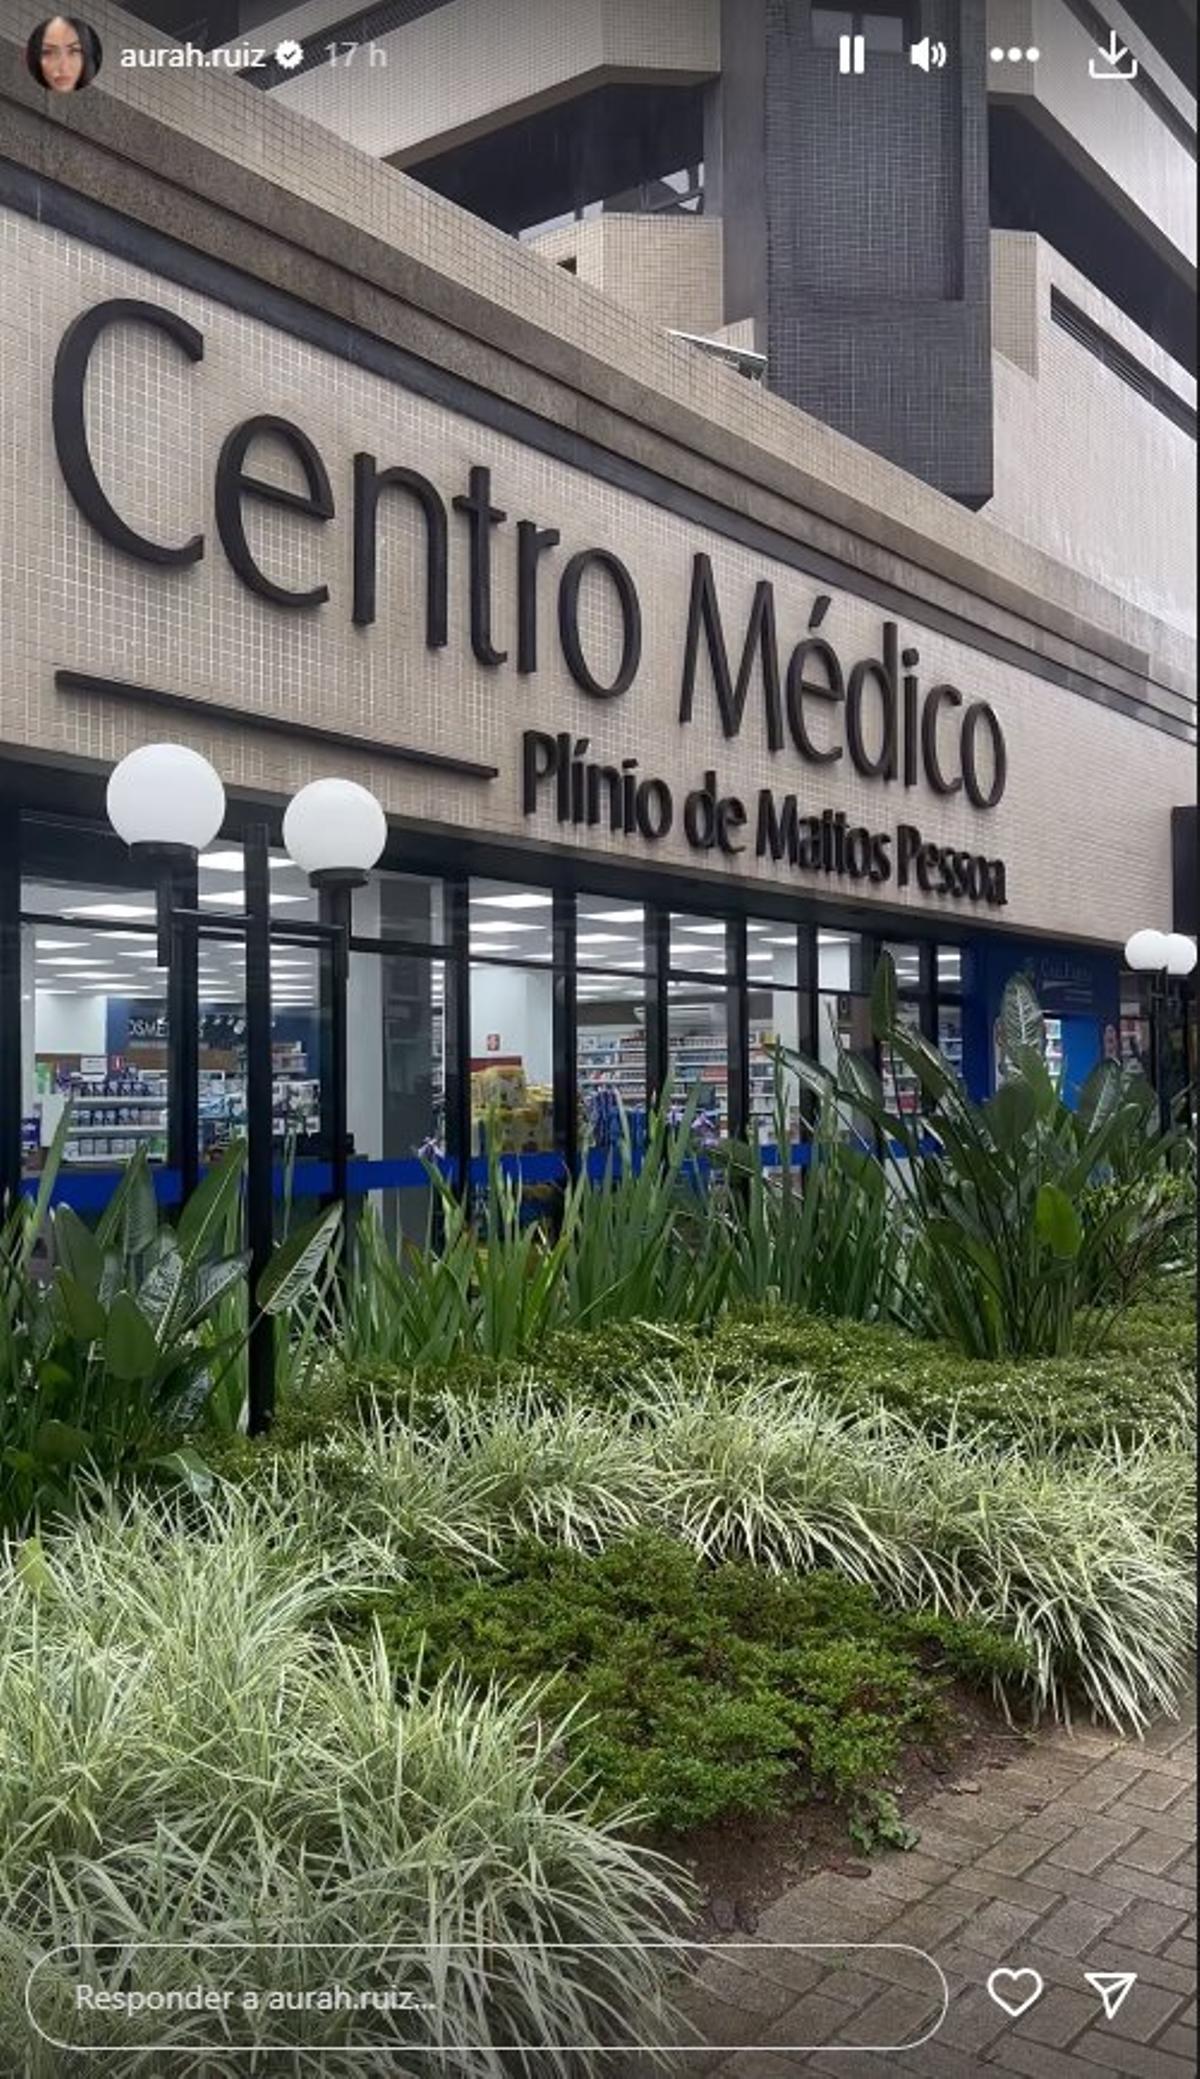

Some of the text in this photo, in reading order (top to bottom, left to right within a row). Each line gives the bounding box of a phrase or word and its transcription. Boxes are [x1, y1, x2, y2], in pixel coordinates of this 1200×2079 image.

[52, 298, 1007, 809] Centro Médico
[523, 729, 1008, 905] Plínio de Mattos Pessoa
